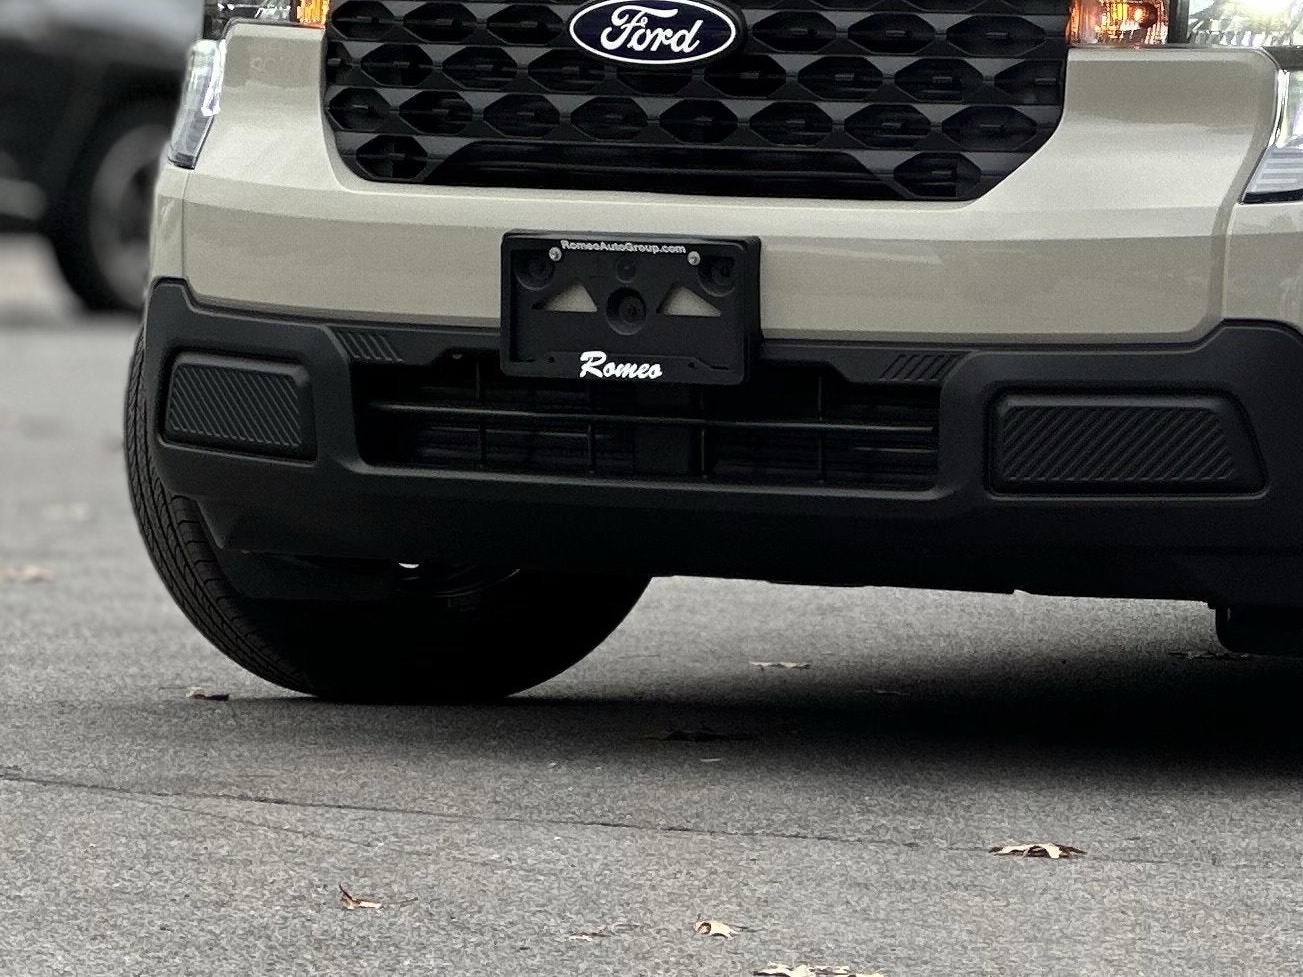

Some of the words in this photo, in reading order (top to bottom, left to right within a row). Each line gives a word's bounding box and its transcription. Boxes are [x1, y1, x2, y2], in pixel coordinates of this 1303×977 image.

[600, 4, 704, 53] Ford
[560, 239, 687, 255] RomeoAutoGroup.com
[579, 350, 663, 380] Romeo
